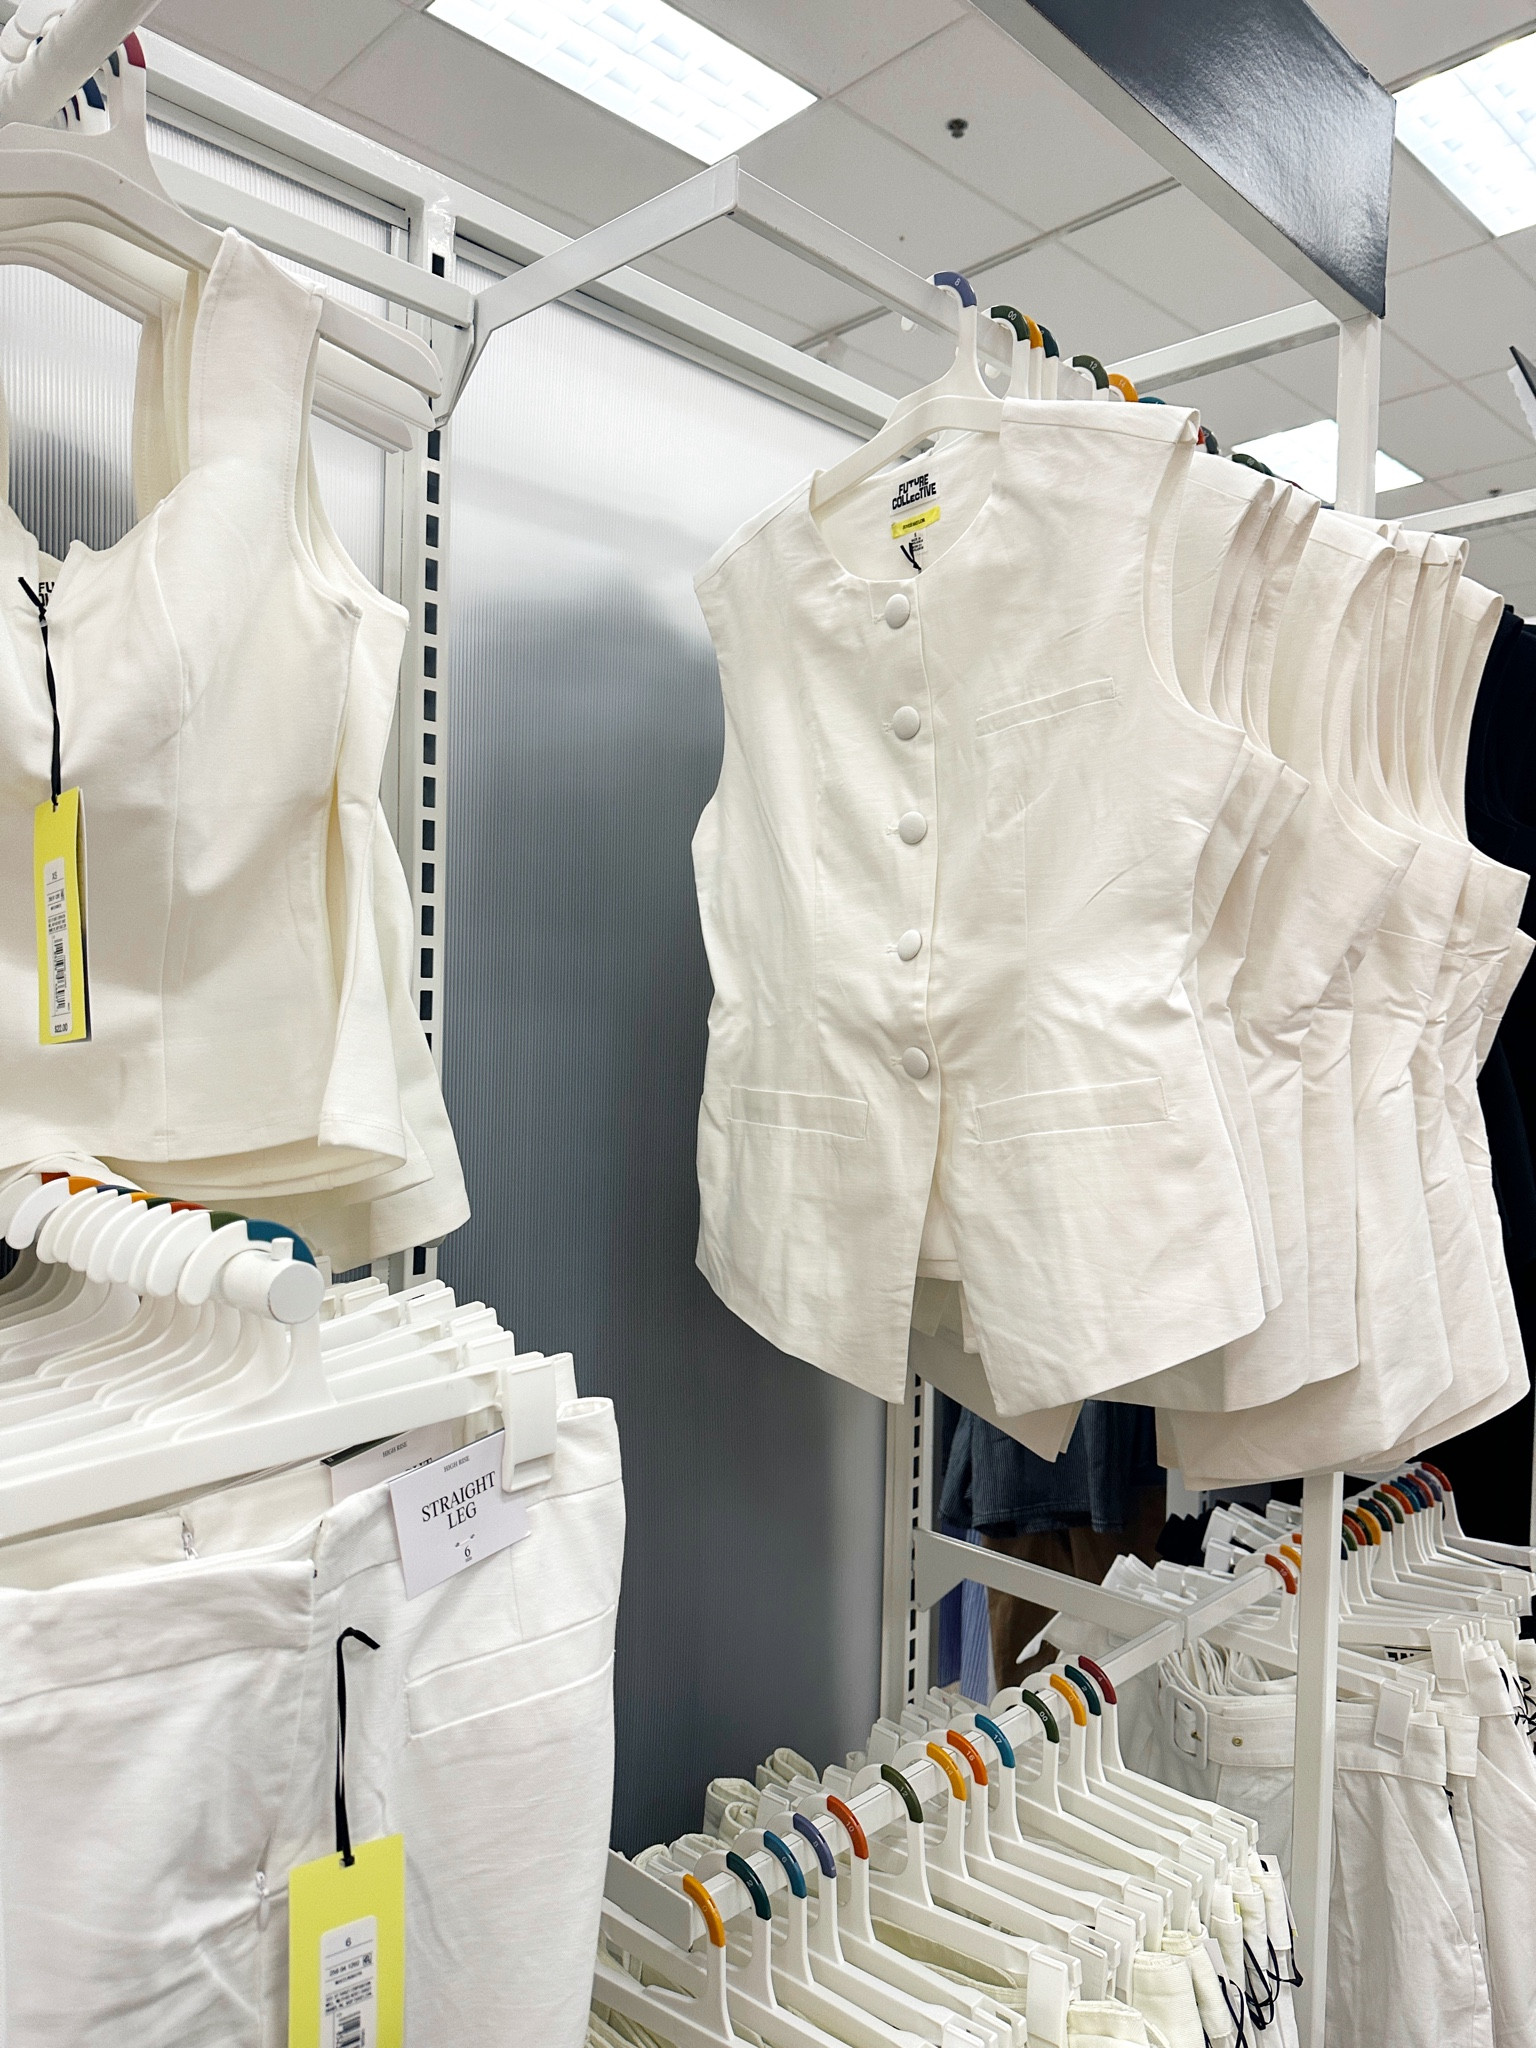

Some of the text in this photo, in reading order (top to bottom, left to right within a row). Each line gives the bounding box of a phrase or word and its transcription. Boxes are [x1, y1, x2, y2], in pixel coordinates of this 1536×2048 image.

[954, 278, 961, 286] 8
[1007, 311, 1017, 321] 00
[1089, 361, 1098, 371] 12
[898, 473, 929, 496] FUTURE
[892, 482, 937, 510] COLLECTIVE
[382, 1441, 408, 1458] HIGH RISE
[443, 1461, 458, 1473] HIGH
[458, 1455, 470, 1466] RISE
[421, 1471, 496, 1523] STRAIGHT
[447, 1501, 478, 1530] LEG
[464, 1545, 471, 1558] 6
[1039, 1711, 1049, 1722] 00
[993, 1734, 1003, 1744] 17
[899, 1786, 909, 1797] 12
[845, 1821, 855, 1833] 10
[746, 1879, 754, 1887] 2
[345, 1936, 352, 1947] 6
